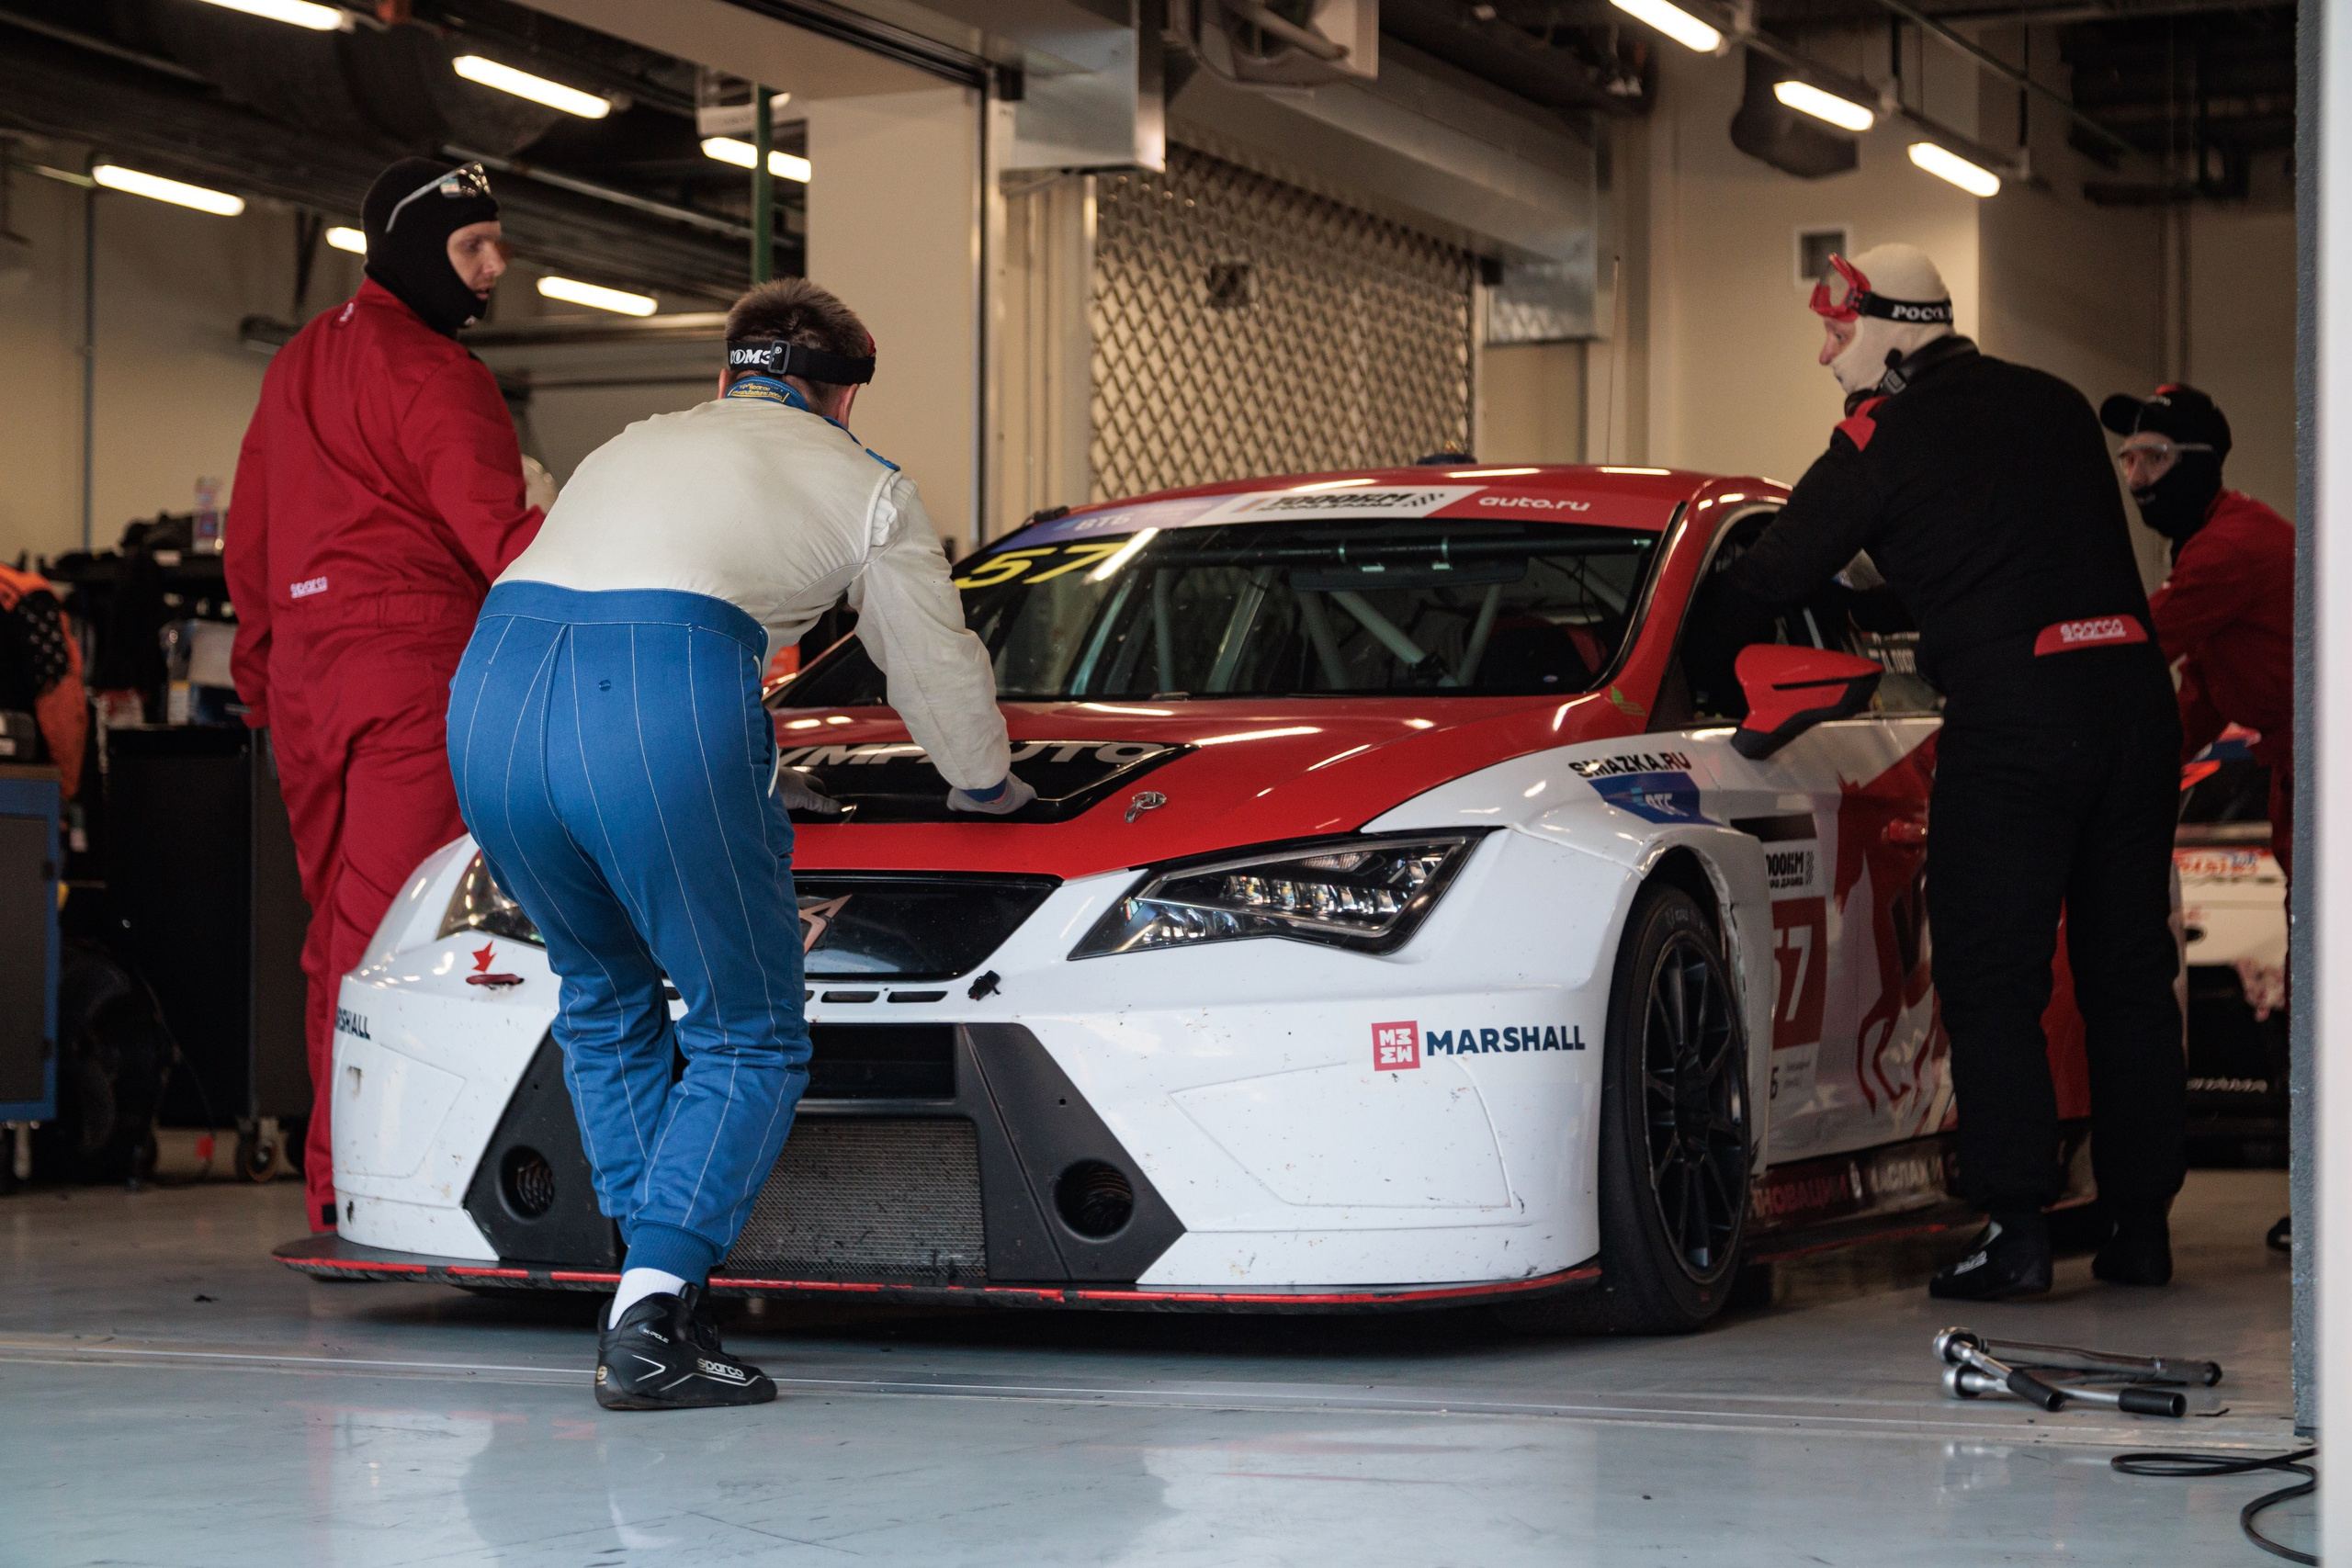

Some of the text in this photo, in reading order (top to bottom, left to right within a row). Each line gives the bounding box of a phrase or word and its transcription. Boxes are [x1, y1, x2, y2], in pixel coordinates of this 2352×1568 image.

[1478, 496, 1591, 512] auto.ru
[953, 540, 1137, 589] 57
[1568, 751, 1692, 778] SMAZKA.RU
[1426, 1025, 1586, 1056] MARSHALL
[696, 1357, 746, 1381] sparco
